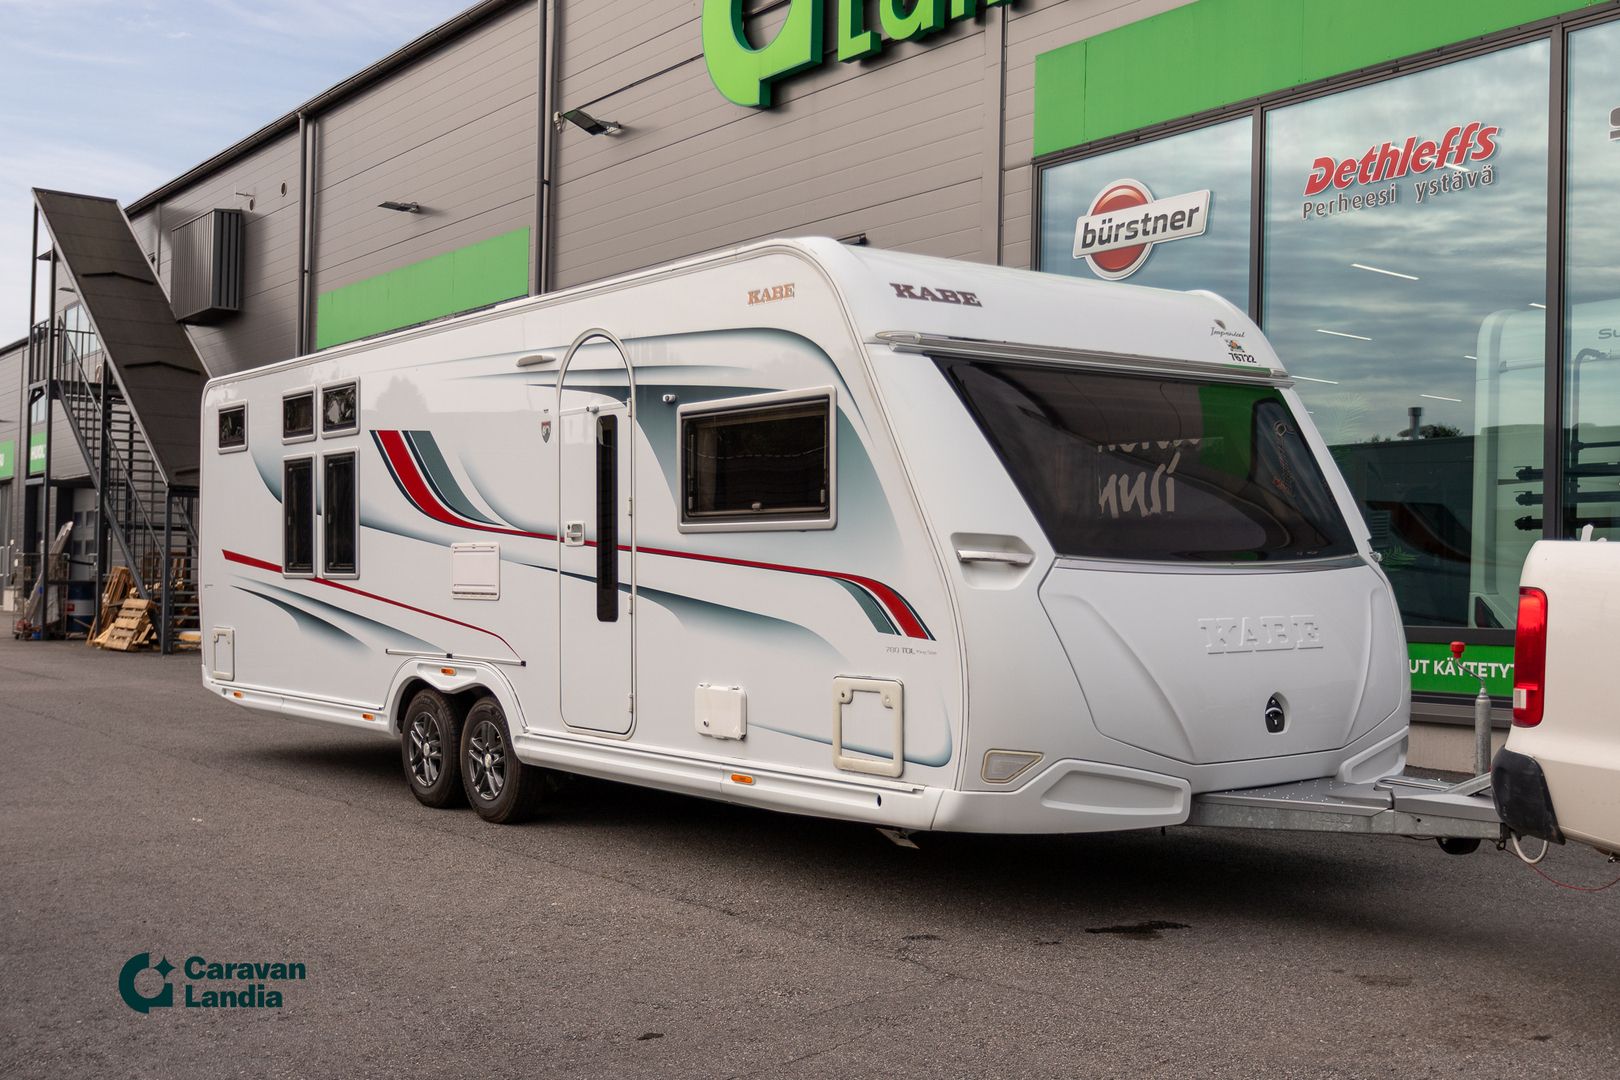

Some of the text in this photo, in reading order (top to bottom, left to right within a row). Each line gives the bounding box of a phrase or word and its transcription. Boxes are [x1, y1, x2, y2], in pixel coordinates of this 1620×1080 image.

[1303, 121, 1498, 196] Dethleffs
[1302, 165, 1493, 219] Perheesi ystävä
[1081, 206, 1200, 249] bürstner
[747, 283, 795, 305] KABE
[889, 282, 983, 307] KABE
[1228, 352, 1257, 363] 76722
[1198, 614, 1323, 654] KABE
[1433, 656, 1514, 678] KÄYTETY
